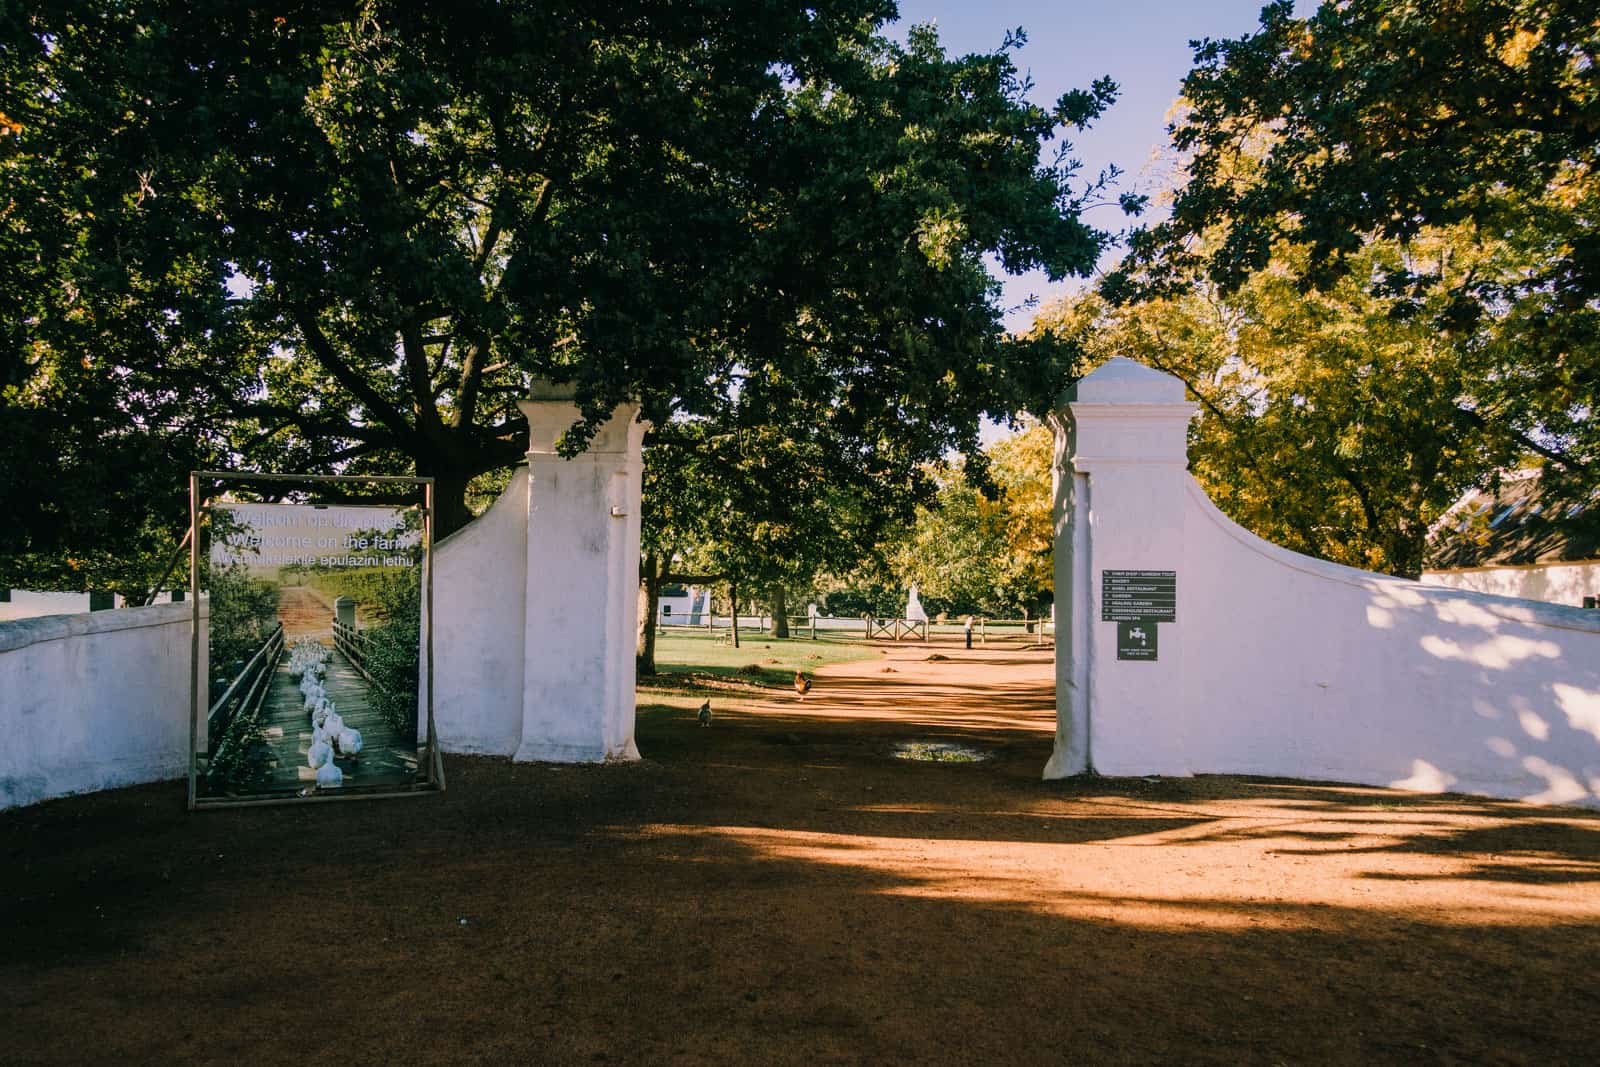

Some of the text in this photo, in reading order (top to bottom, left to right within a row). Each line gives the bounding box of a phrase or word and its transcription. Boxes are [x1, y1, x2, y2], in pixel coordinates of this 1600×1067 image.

[231, 532, 409, 550] Welcome on the farm
[320, 554, 378, 568] epulazini
[383, 555, 414, 567] lethu
